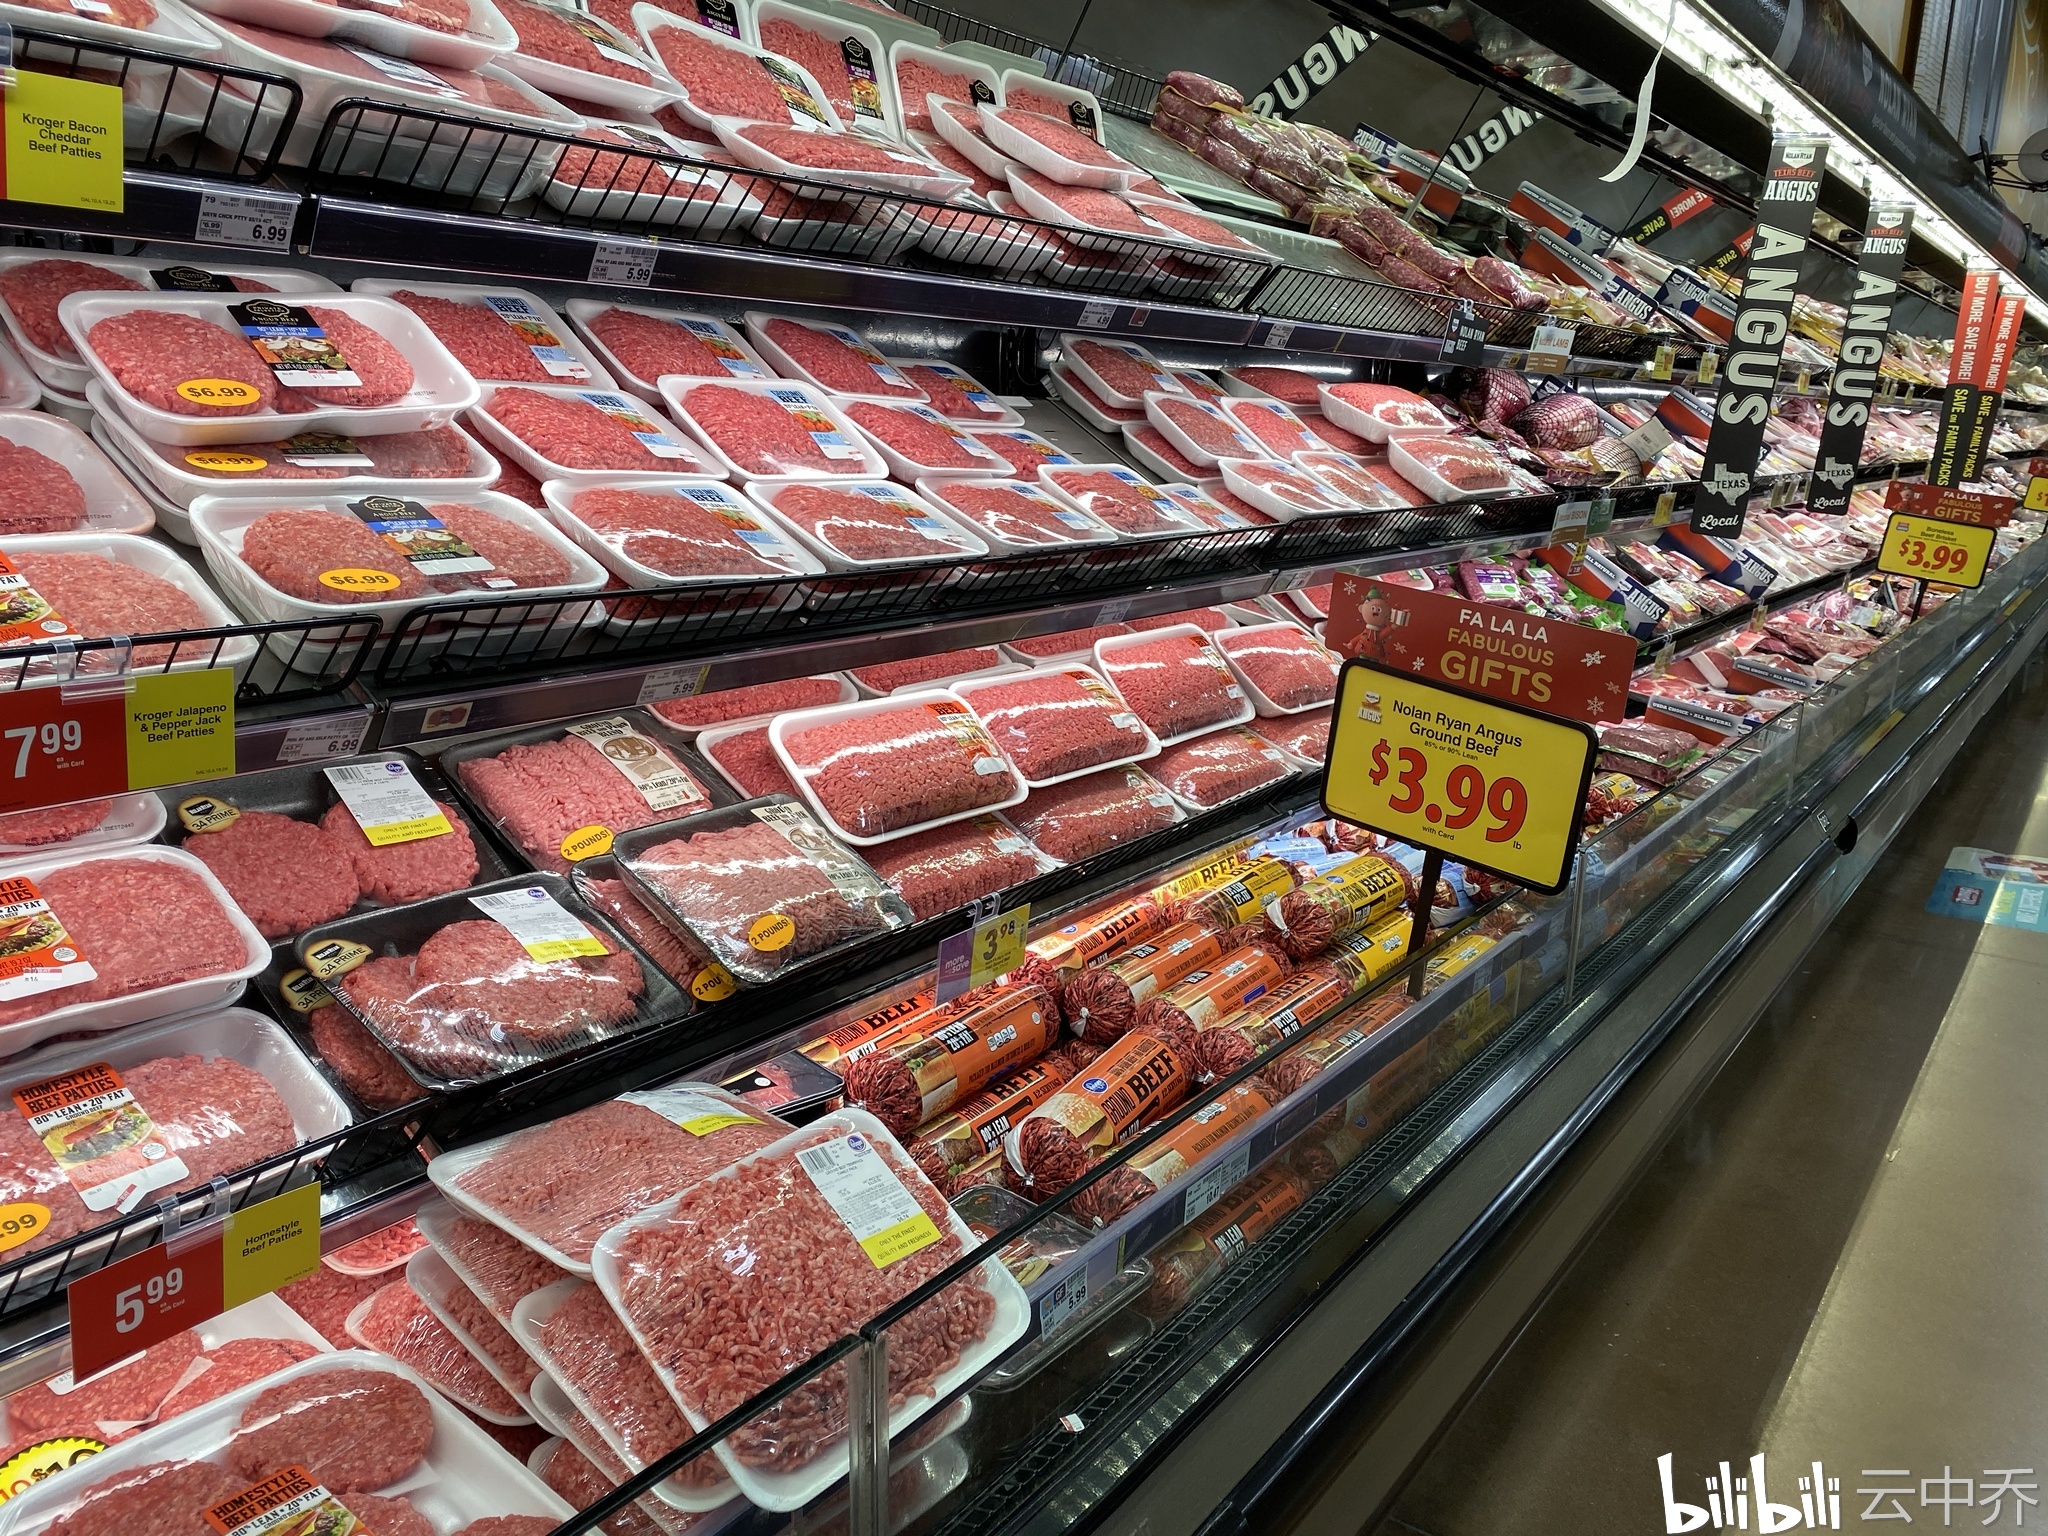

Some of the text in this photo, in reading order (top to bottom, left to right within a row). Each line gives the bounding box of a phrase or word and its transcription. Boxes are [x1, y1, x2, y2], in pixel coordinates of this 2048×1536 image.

[22, 113, 108, 136] Kroger Bacon
[39, 128, 92, 146] Cheddar
[28, 139, 102, 160] Beef Patties
[1774, 168, 1797, 178] TEXAS
[1763, 180, 1819, 202] ANGUS
[252, 224, 287, 242] 6.99
[1862, 238, 1907, 254] ANGUS
[1552, 244, 1603, 281] CHOICE NATURAL
[626, 267, 650, 281] 5.99
[494, 304, 530, 314] BEEF
[1613, 287, 1652, 320] ANGUS
[1718, 224, 1806, 426] ANGUS
[1958, 276, 1990, 381] BUY MORE, SAVE MORE!
[1455, 339, 1468, 351] BEEF
[1552, 338, 1569, 348] LAMB
[1828, 272, 1897, 427] ANGUS
[1985, 300, 2019, 389] BUY SAVE MORE!
[187, 386, 247, 398] $6.99
[778, 396, 808, 404] BEEF
[1937, 388, 1968, 487] SAVE FAMILY PACKS
[1962, 395, 1994, 478] SAVE FAMILY PACKS
[195, 456, 254, 465] $6.99
[1826, 468, 1852, 477] TEXAS
[1715, 479, 1746, 490] TEXAS
[692, 494, 726, 503] BEEF
[1813, 496, 1846, 508] Local
[1938, 498, 1983, 510] FABULOUS
[1955, 493, 1981, 502] LA LA
[1699, 514, 1739, 530] Local
[1934, 506, 1982, 523] GIFTS
[1920, 531, 1935, 539] Beef
[1935, 533, 1957, 543] Brisket
[1899, 538, 1968, 574] $3.99
[330, 574, 389, 586] $6.99
[1594, 561, 1616, 580] NATURAL
[1743, 558, 1775, 584] ANGUS
[1627, 590, 1665, 622] ANGUS
[1459, 608, 1549, 644] FA LA LA
[1447, 628, 1555, 667] FABULOUS
[1440, 650, 1553, 703] GIFTS
[672, 682, 696, 695] 5.99
[134, 703, 227, 722] Kroger Jalapeno
[1652, 702, 1668, 710] USDA
[1668, 706, 1689, 716] CHOICE
[1705, 715, 1732, 727] NATURAL
[140, 715, 222, 733] & Pepper Jack
[147, 726, 215, 743] Beef Patties
[1392, 699, 1523, 749] Nolan Ryan Angus
[328, 739, 359, 752] 6.99
[1409, 721, 1499, 758] Ground Beef
[71, 759, 85, 767] Card
[1462, 750, 1479, 762] Lean
[1369, 738, 1529, 843] $3.99
[192, 808, 236, 831] 34 PRIME
[377, 833, 401, 841] QUALITY
[414, 826, 443, 836] FRESHNESS
[564, 829, 611, 856] 2 POUNDS!
[1422, 824, 1455, 841] with Card
[1512, 840, 1522, 850] lb
[1178, 856, 1239, 896] GROUND BEEF
[1340, 867, 1398, 904] GROUND BEEF
[25, 900, 41, 911] FAT
[751, 919, 789, 945] 2 POUNDS!
[1074, 903, 1143, 956] GROUND BEEF
[321, 946, 365, 976] 34 PRIME
[945, 954, 965, 969] more
[952, 960, 970, 974] save
[695, 987, 703, 996] 2
[298, 997, 314, 1009] 34
[827, 994, 927, 1047] GROUND BEEF
[18, 1065, 109, 1101] HOMESTYLE
[957, 1060, 1049, 1122] GROUND BEEF
[1101, 1086, 1136, 1126] GROUND
[1125, 1048, 1176, 1104] BEEF
[26, 1077, 117, 1114] BEEF PATTIES
[55, 1103, 83, 1119] LEAN
[108, 1090, 126, 1102] FAT
[65, 1109, 90, 1121] GROUND
[90, 1104, 103, 1114] BEEF
[242, 1227, 303, 1257] Beef Patties
[245, 1219, 300, 1247] Homestyle
[879, 1225, 917, 1246] ONLY THE FINEST
[877, 1231, 932, 1260] QUALITY AND FRESHNESS
[160, 1299, 185, 1314] with Card
[1068, 1285, 1086, 1309] 5.99
[211, 1469, 303, 1518] HOMESTYLE
[223, 1480, 313, 1531] BEEF PATTIES
[251, 1488, 323, 1531] LEAN FAT
[264, 1507, 301, 1530] GROUND BEEF
